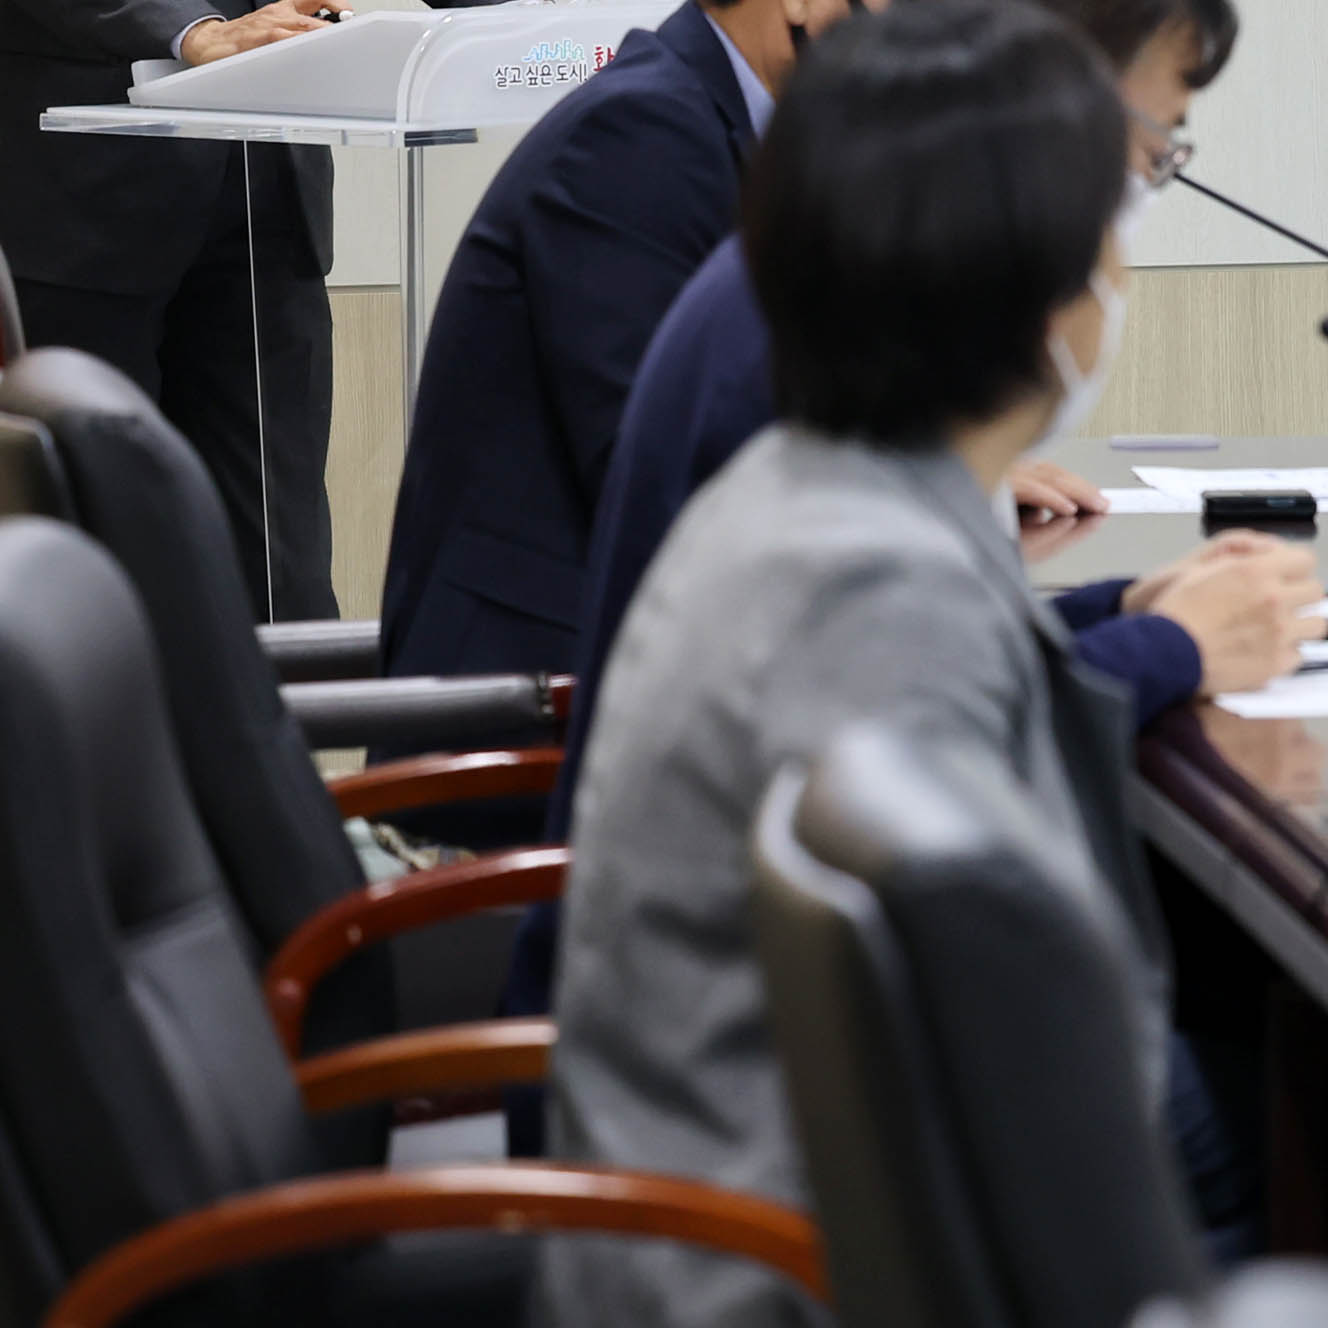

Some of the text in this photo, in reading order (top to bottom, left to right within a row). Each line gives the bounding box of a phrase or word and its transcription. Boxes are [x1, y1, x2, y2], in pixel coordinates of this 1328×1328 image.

[495, 63, 588, 87] 살고 싶은 도시!
